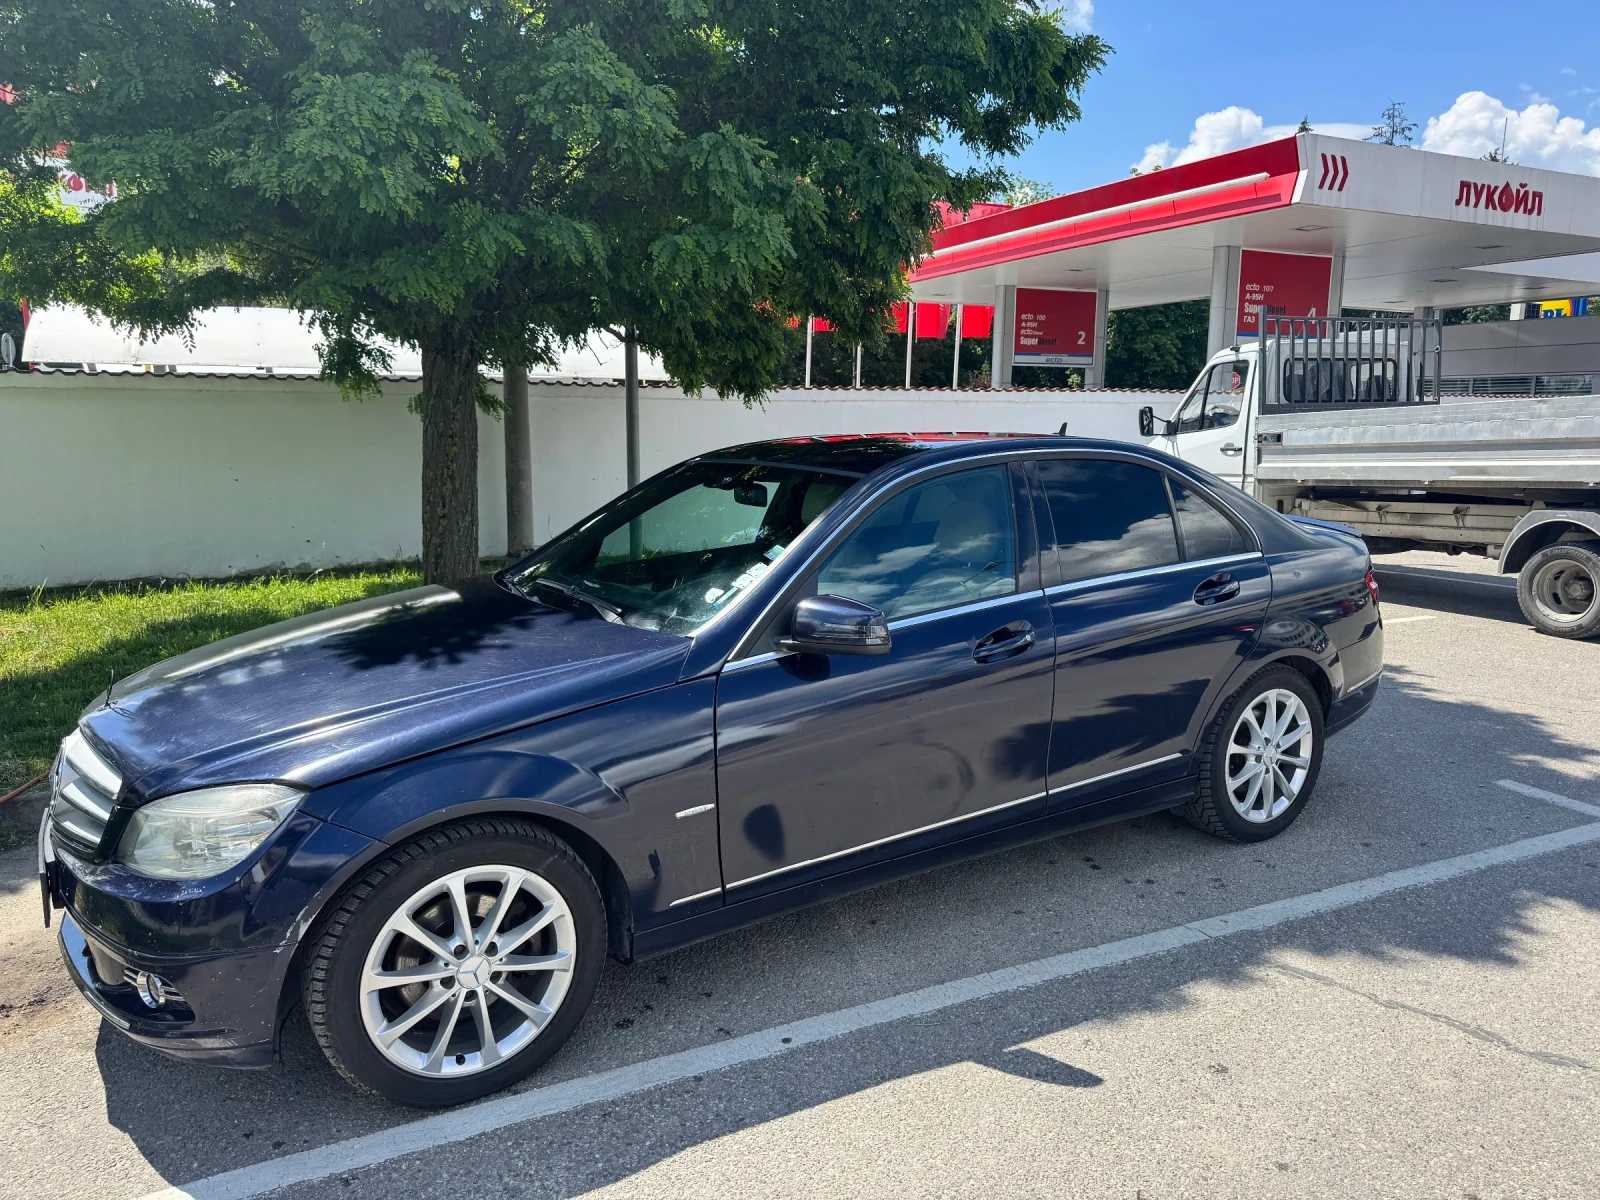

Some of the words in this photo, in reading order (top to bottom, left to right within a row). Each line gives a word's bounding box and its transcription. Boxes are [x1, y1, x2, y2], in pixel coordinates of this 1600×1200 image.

[1455, 180, 1544, 216] ЛУКОЙЛ
[1245, 283, 1260, 291] ecto
[1077, 331, 1086, 345] 2
